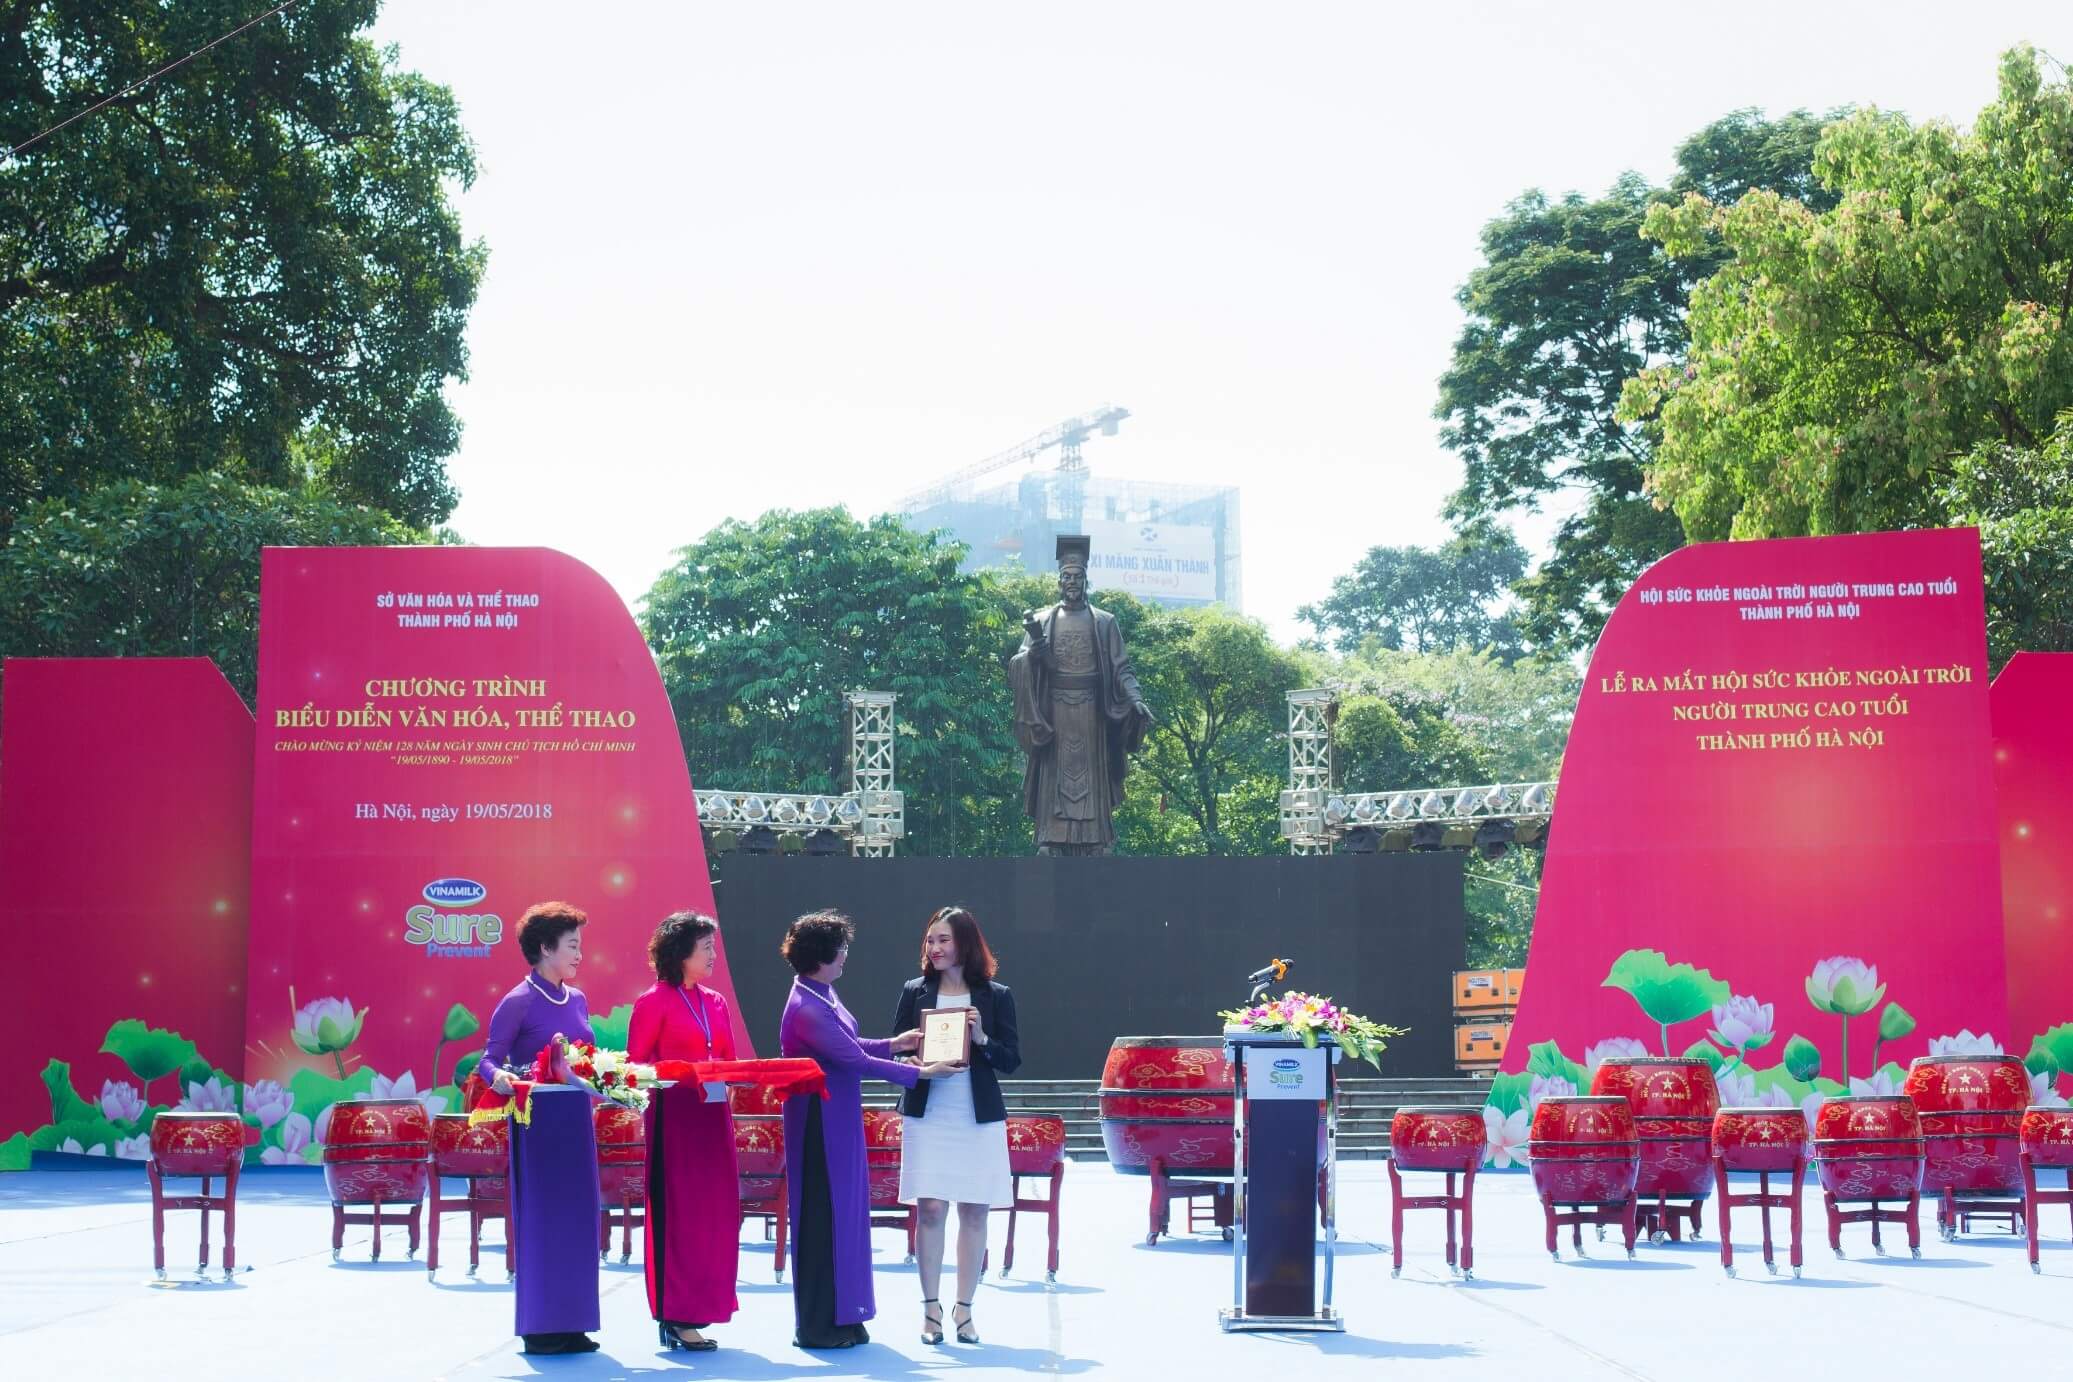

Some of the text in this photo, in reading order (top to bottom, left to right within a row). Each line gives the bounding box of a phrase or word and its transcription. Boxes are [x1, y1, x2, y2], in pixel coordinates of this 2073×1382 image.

[377, 590, 539, 607] SỞ VĂN HÓA VÀ THỂ THAO
[1640, 589, 1663, 605] HỘI
[1667, 587, 1692, 603] SỨC
[1734, 584, 1772, 600] NGOÀI
[1776, 584, 1805, 599] TRỜI
[1809, 582, 1848, 598] NGƯỜI
[1852, 584, 1895, 597] TRUNG
[1898, 582, 1924, 596] CAO
[1927, 576, 1957, 595] TUỔI
[398, 611, 517, 629] THÀNH PHỐ HÀ NỘI
[1740, 602, 1860, 620] THÀNH PHỐ HÀ NỘI
[365, 675, 546, 696] CHƯƠNG TRÌNH
[1601, 671, 1626, 693] LỄ
[1632, 677, 1658, 692] RA
[1664, 669, 1707, 691] MẮT
[1712, 671, 1747, 692] HỘI
[1753, 669, 1790, 688] SỨC
[1856, 666, 1919, 685] NGOÀI
[1924, 665, 1972, 683] TRỜI
[1673, 693, 1909, 720] NGƯỜI TRUNG CAO TUỔI
[276, 702, 636, 730] BIỂU DIỄN VĂN HÓA, THỂ THAO
[396, 741, 413, 751] 128
[477, 742, 502, 751] SINH
[605, 742, 635, 751] MINH
[1696, 726, 1884, 750] THÀNH PHỐ HÀ NỘI
[355, 804, 552, 822] Hà Nội, ngày 19/05/2018
[429, 887, 481, 897] VINAMILK
[404, 905, 503, 945] Sure
[427, 943, 491, 958] Prevent
[1270, 1070, 1304, 1084] Sure
